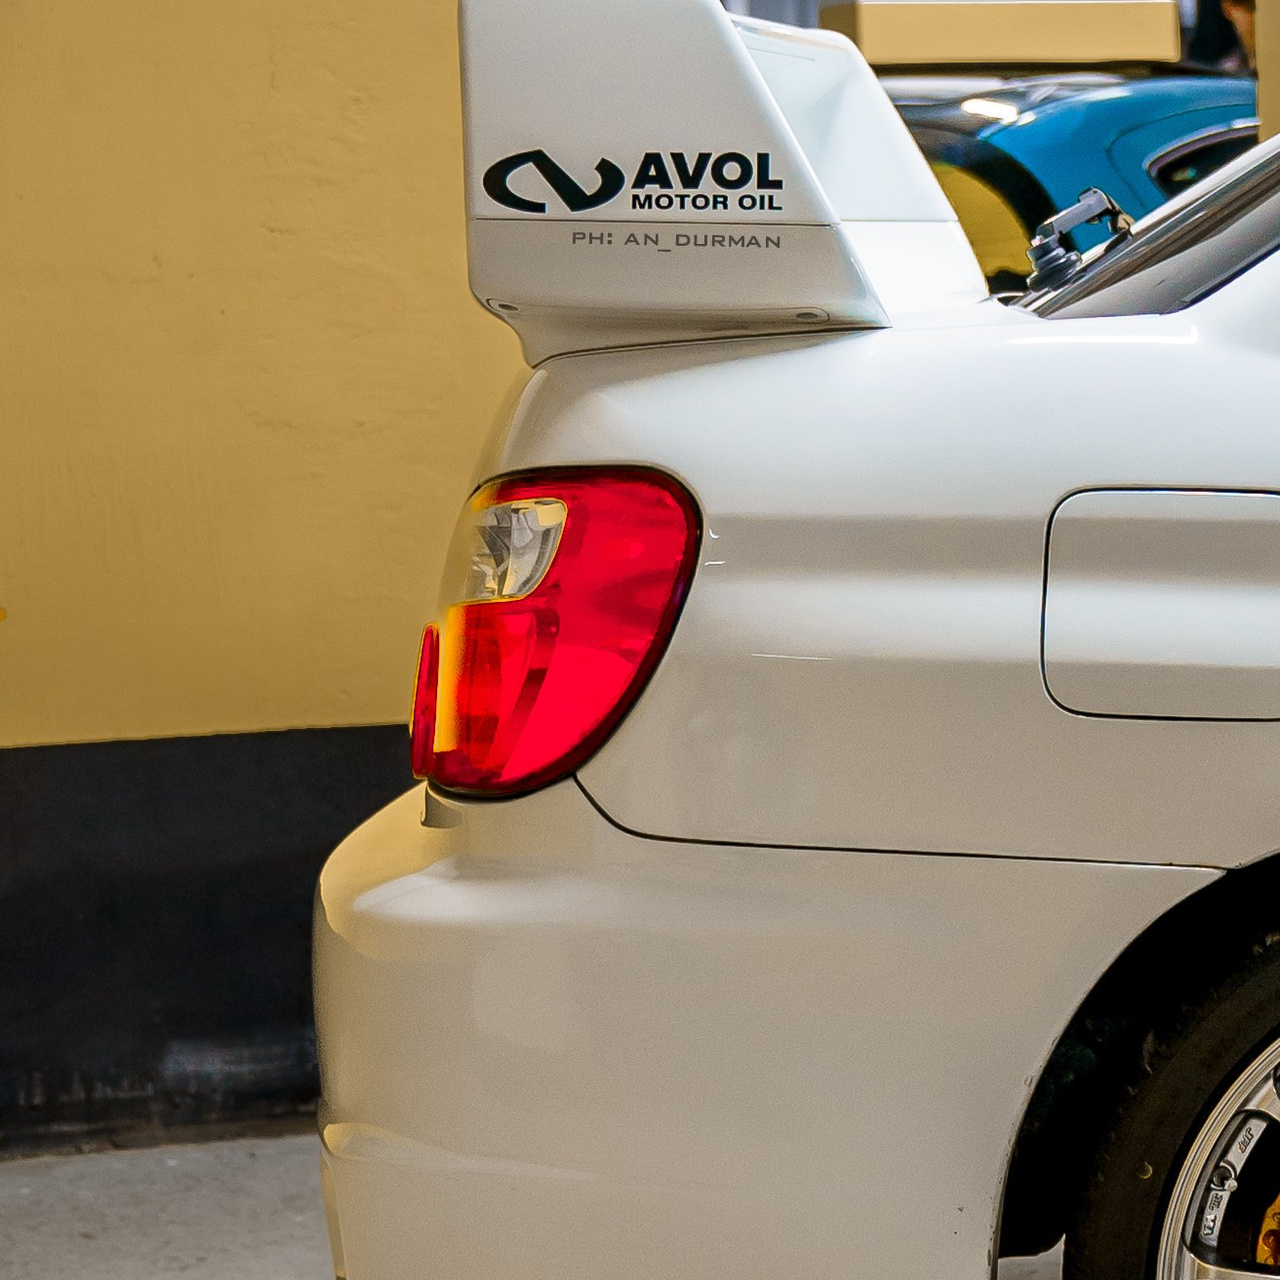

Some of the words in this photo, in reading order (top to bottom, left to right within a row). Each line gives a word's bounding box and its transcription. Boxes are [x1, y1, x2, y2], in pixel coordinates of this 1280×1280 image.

[631, 152, 782, 189] AVOL
[632, 194, 728, 210] MOTOR
[739, 195, 782, 210] OIL
